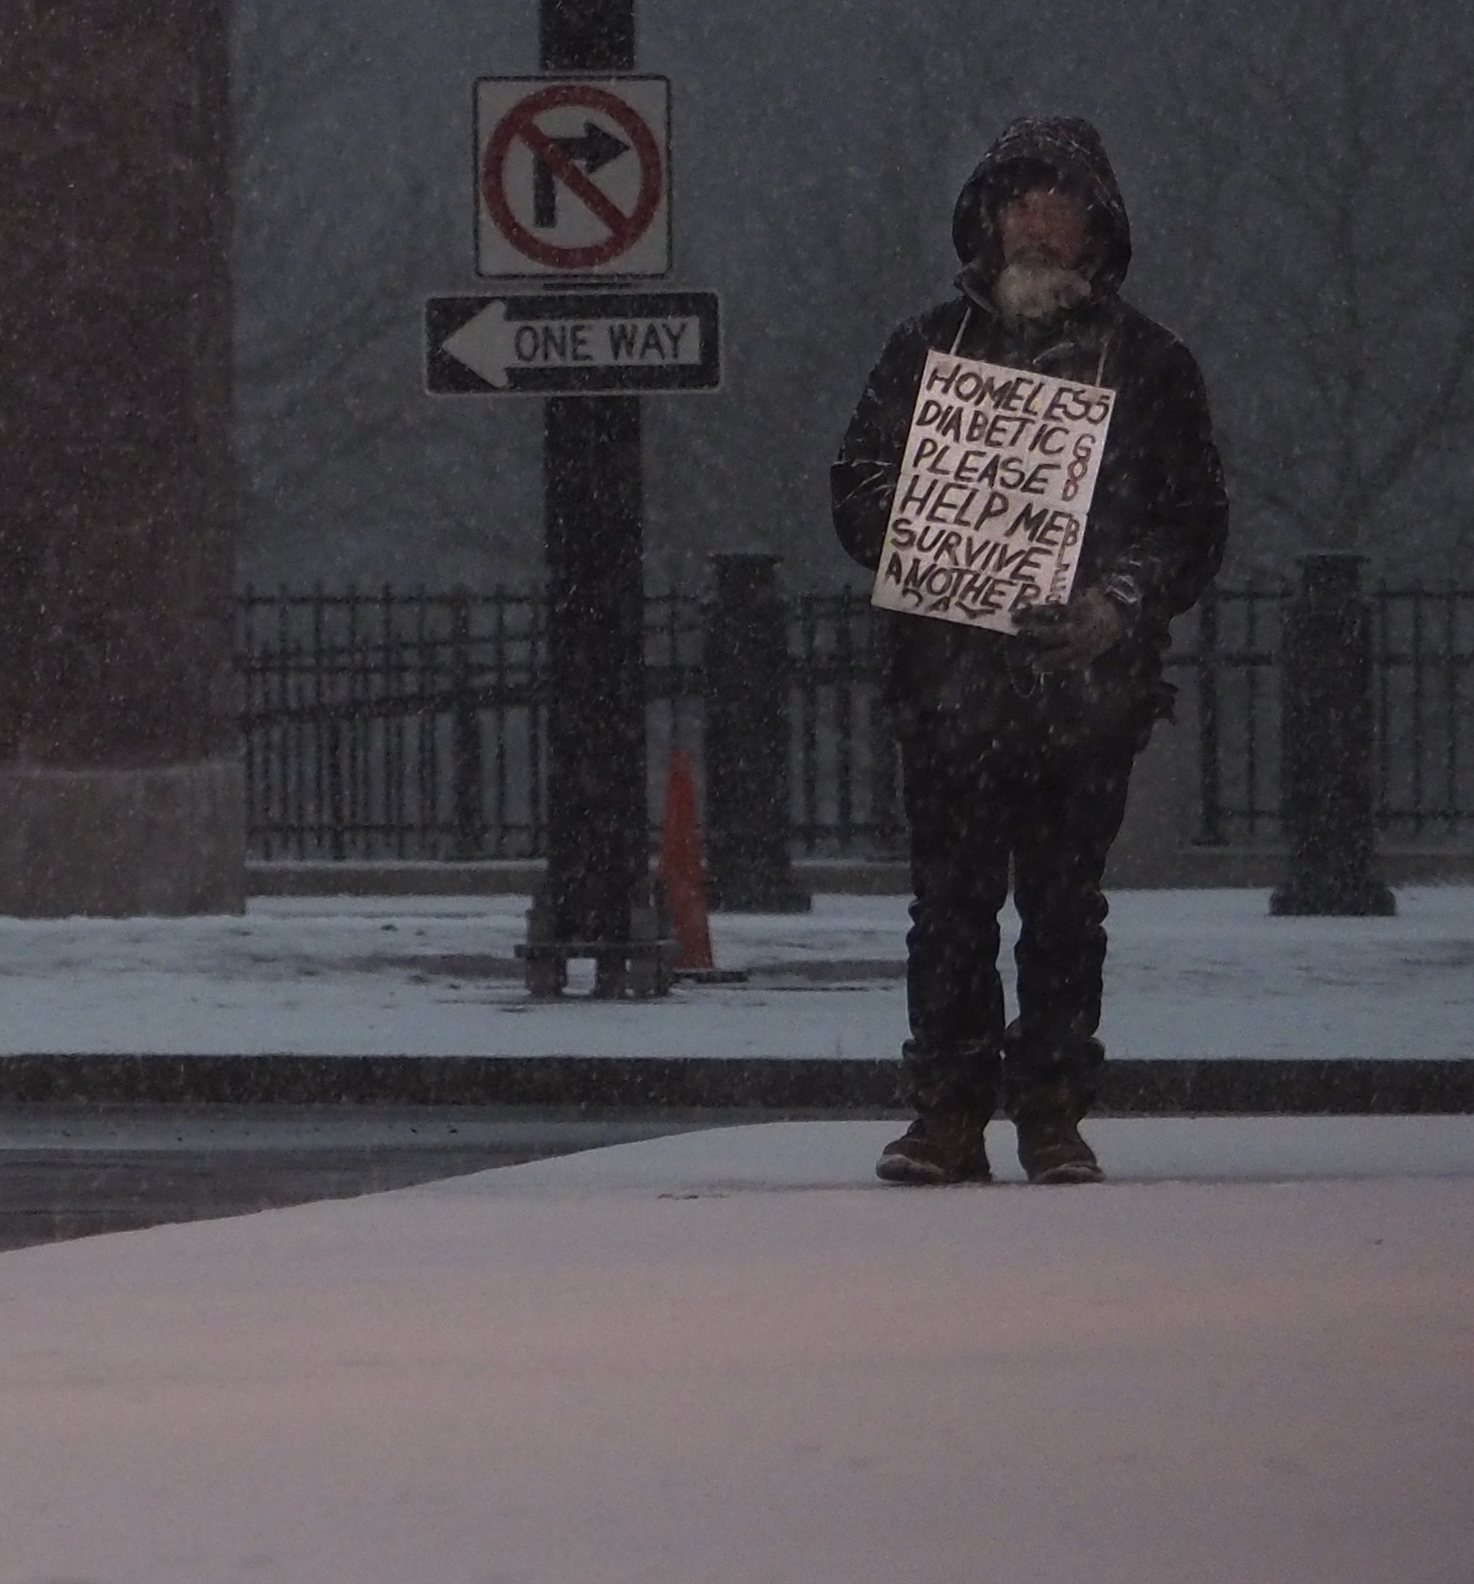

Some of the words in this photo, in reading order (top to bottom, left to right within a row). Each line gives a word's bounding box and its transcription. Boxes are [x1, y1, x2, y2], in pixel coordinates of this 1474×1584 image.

[514, 323, 593, 362] ONE
[609, 322, 688, 361] WAY
[926, 365, 1110, 425] HOMELESS
[916, 400, 1070, 455] DIABETIC
[913, 438, 1061, 494] PLEASE
[1061, 433, 1096, 501] GOD
[899, 475, 1009, 531] HELP
[1004, 502, 1072, 547] ME
[891, 518, 1054, 582] SURVIVE
[884, 552, 1041, 613] ANOTHER
